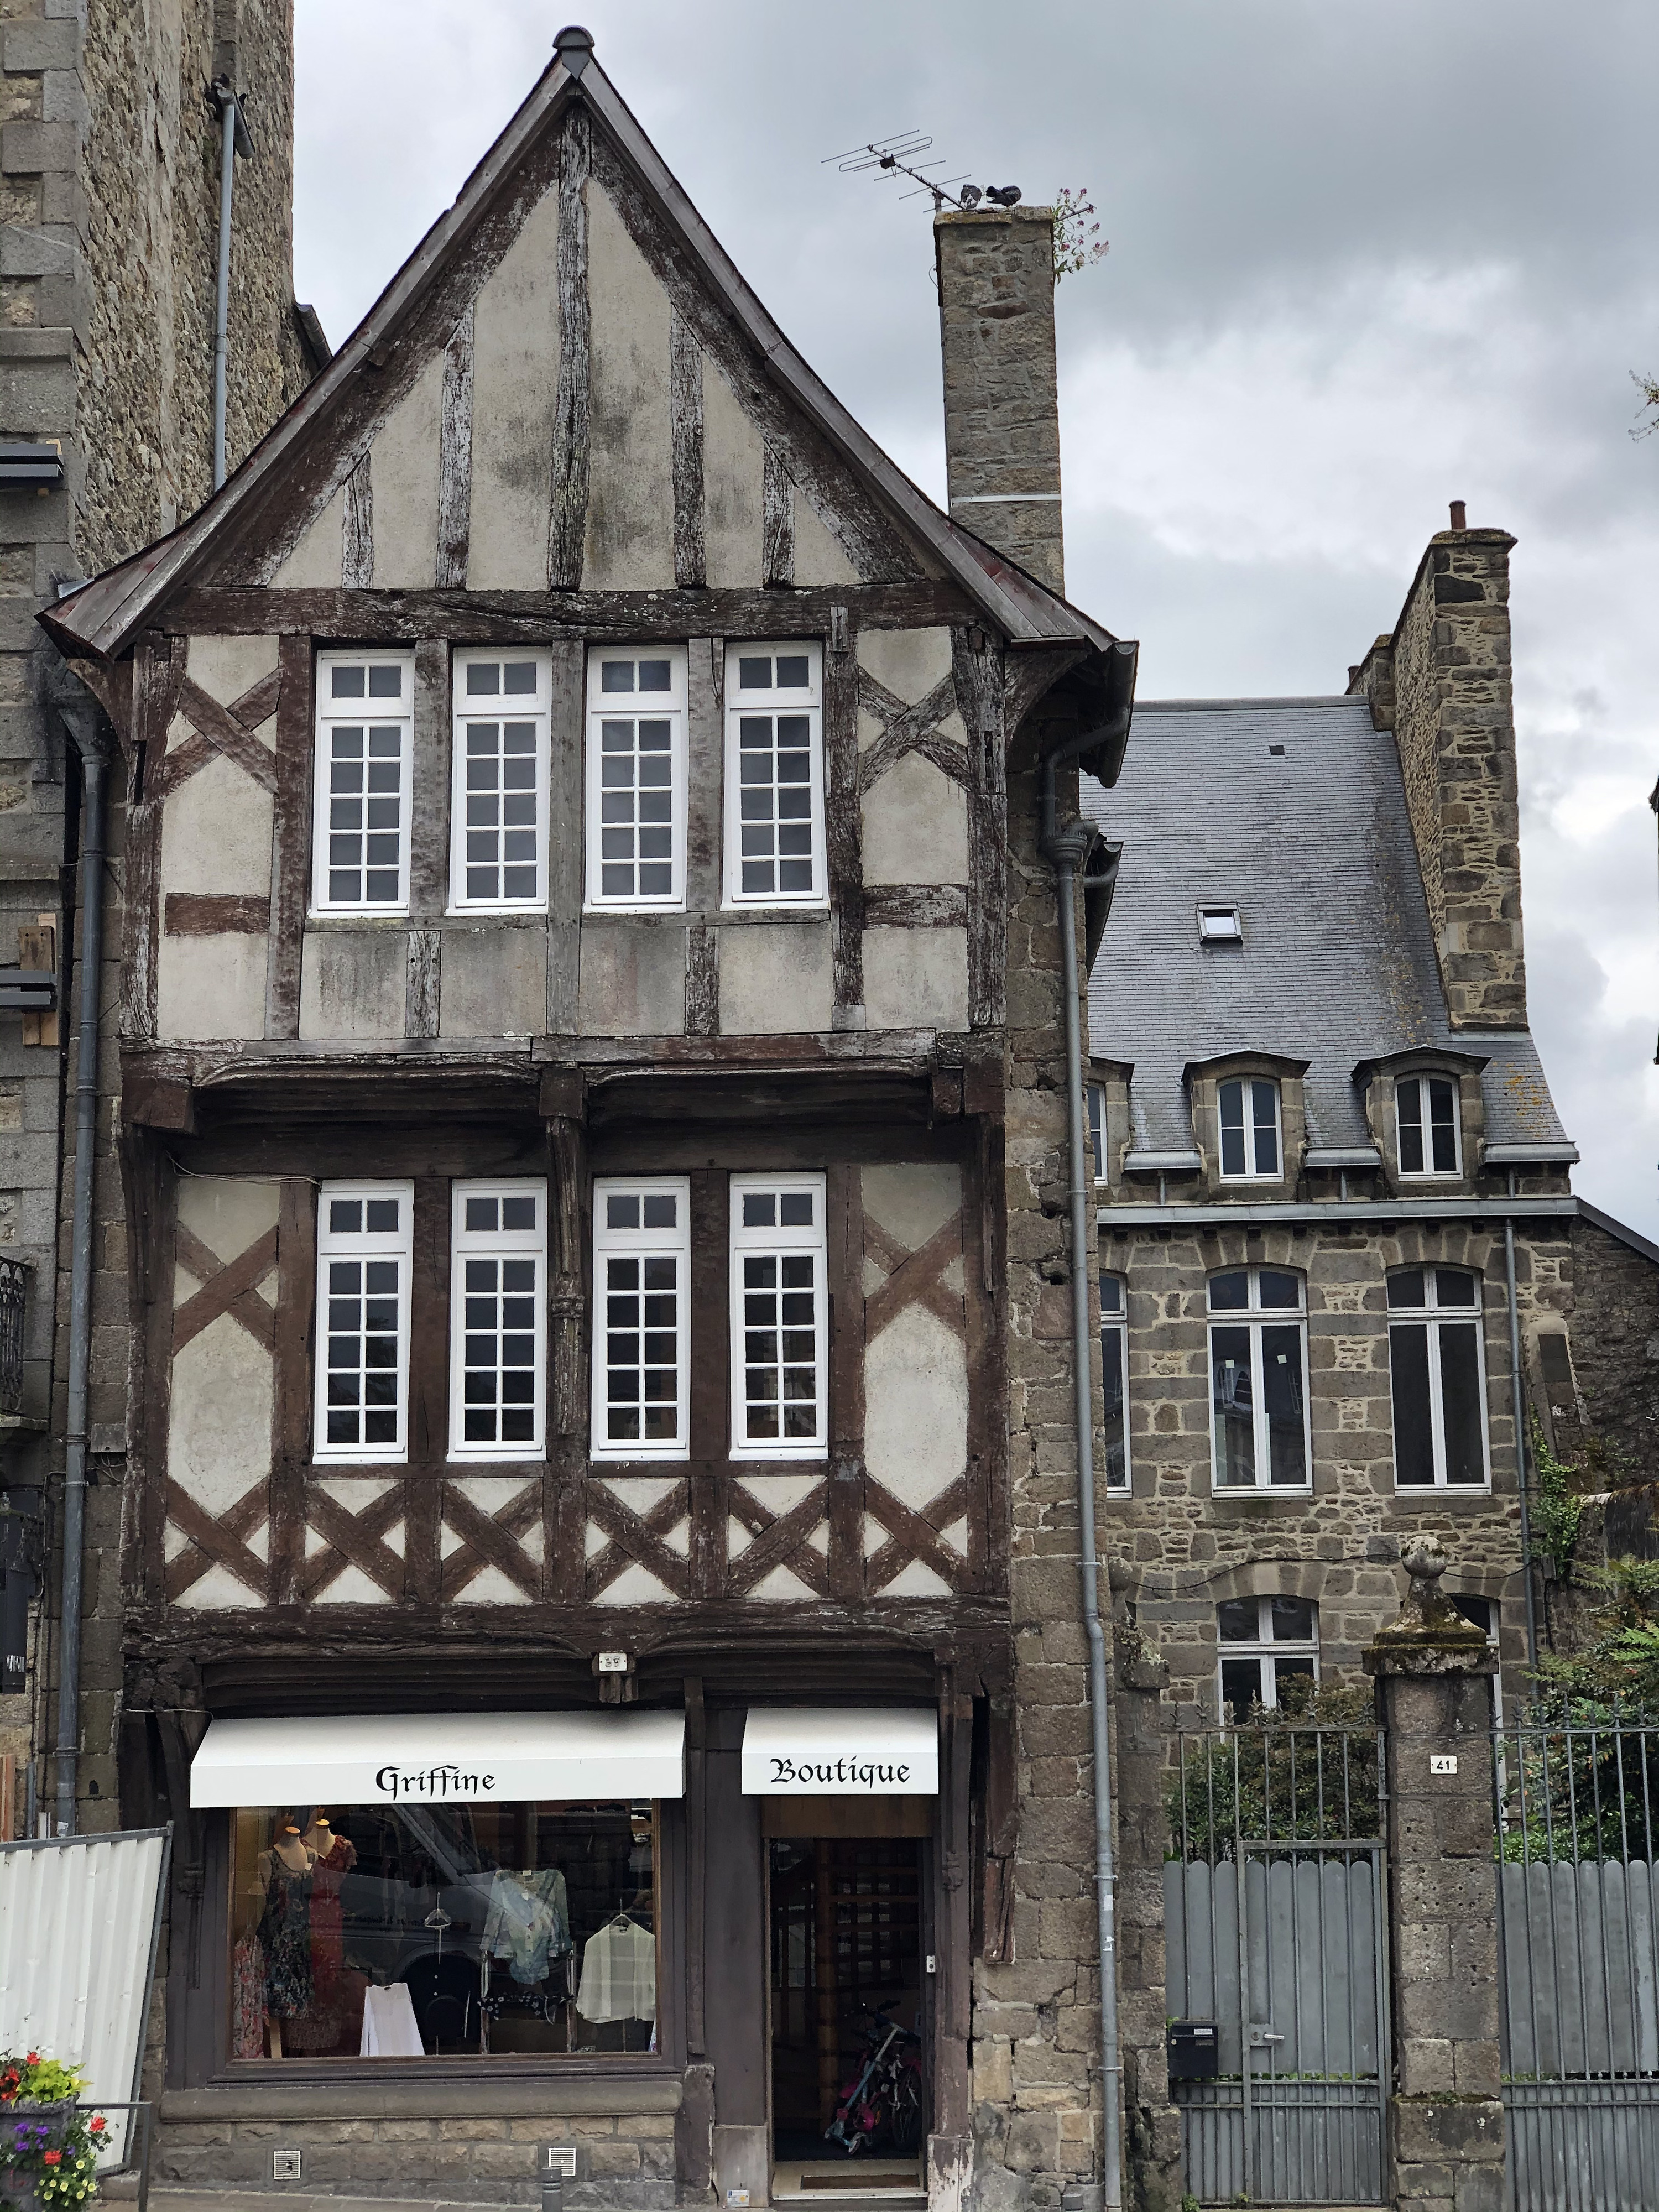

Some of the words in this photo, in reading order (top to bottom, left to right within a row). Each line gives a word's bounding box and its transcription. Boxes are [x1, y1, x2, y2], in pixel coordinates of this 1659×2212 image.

[770, 1755, 910, 1788] Boutique
[1437, 1760, 1449, 1770] 41
[376, 1765, 495, 1801] Griffine
